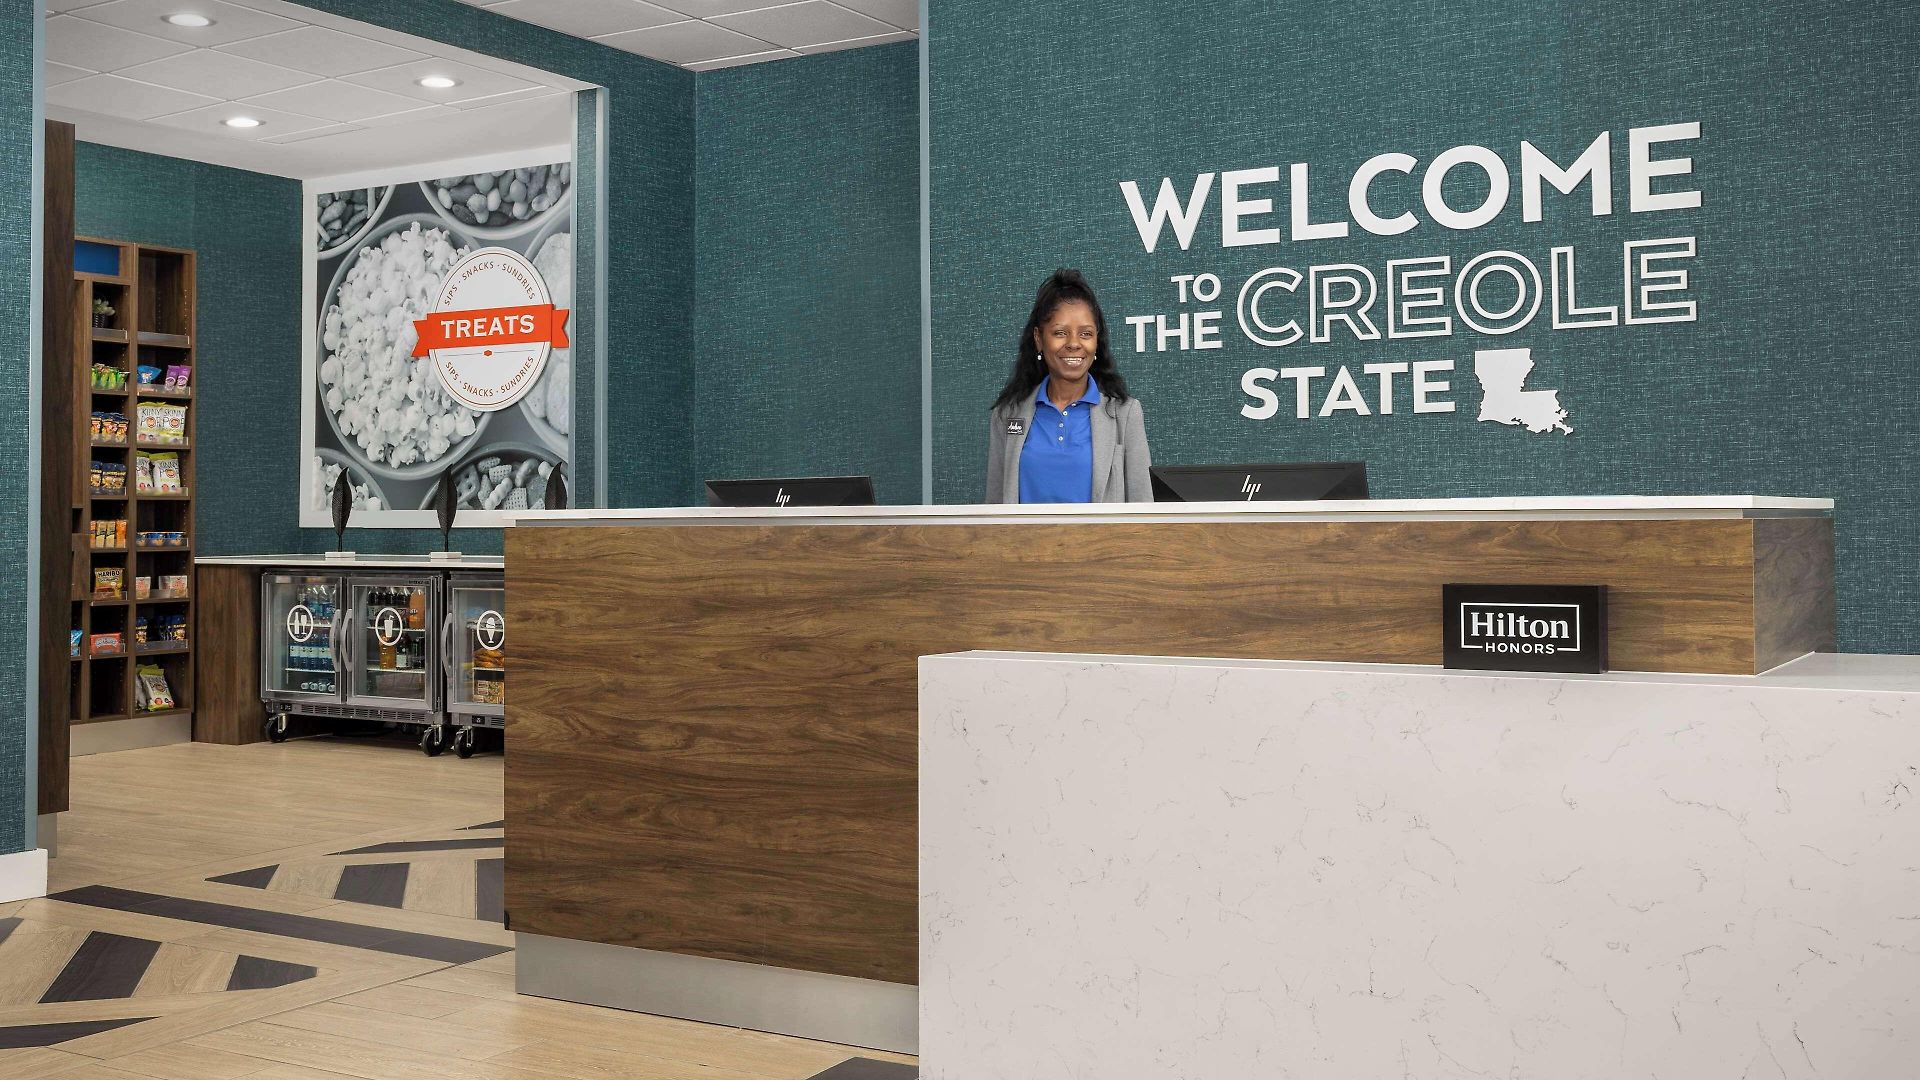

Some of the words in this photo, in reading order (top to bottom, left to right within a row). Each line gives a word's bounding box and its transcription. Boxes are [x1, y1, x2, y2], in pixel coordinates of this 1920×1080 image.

[1119, 121, 1702, 254] WELCOME
[444, 285, 458, 306] SIPS
[462, 261, 494, 281] SNACKS
[502, 263, 536, 300] SUNDRIES
[1125, 310, 1223, 352] THE
[1237, 236, 1697, 347] CREOLE
[1171, 273, 1221, 303] TO
[440, 314, 535, 339] TREATS
[445, 362, 459, 381] SIPS
[463, 382, 494, 397] SNACKS
[501, 356, 534, 394] SUNDRIES
[1240, 359, 1457, 420] STATE
[775, 487, 790, 507] hp
[1241, 474, 1262, 501] hp
[1470, 611, 1570, 639] Hilton
[1485, 641, 1555, 655] HONORS
